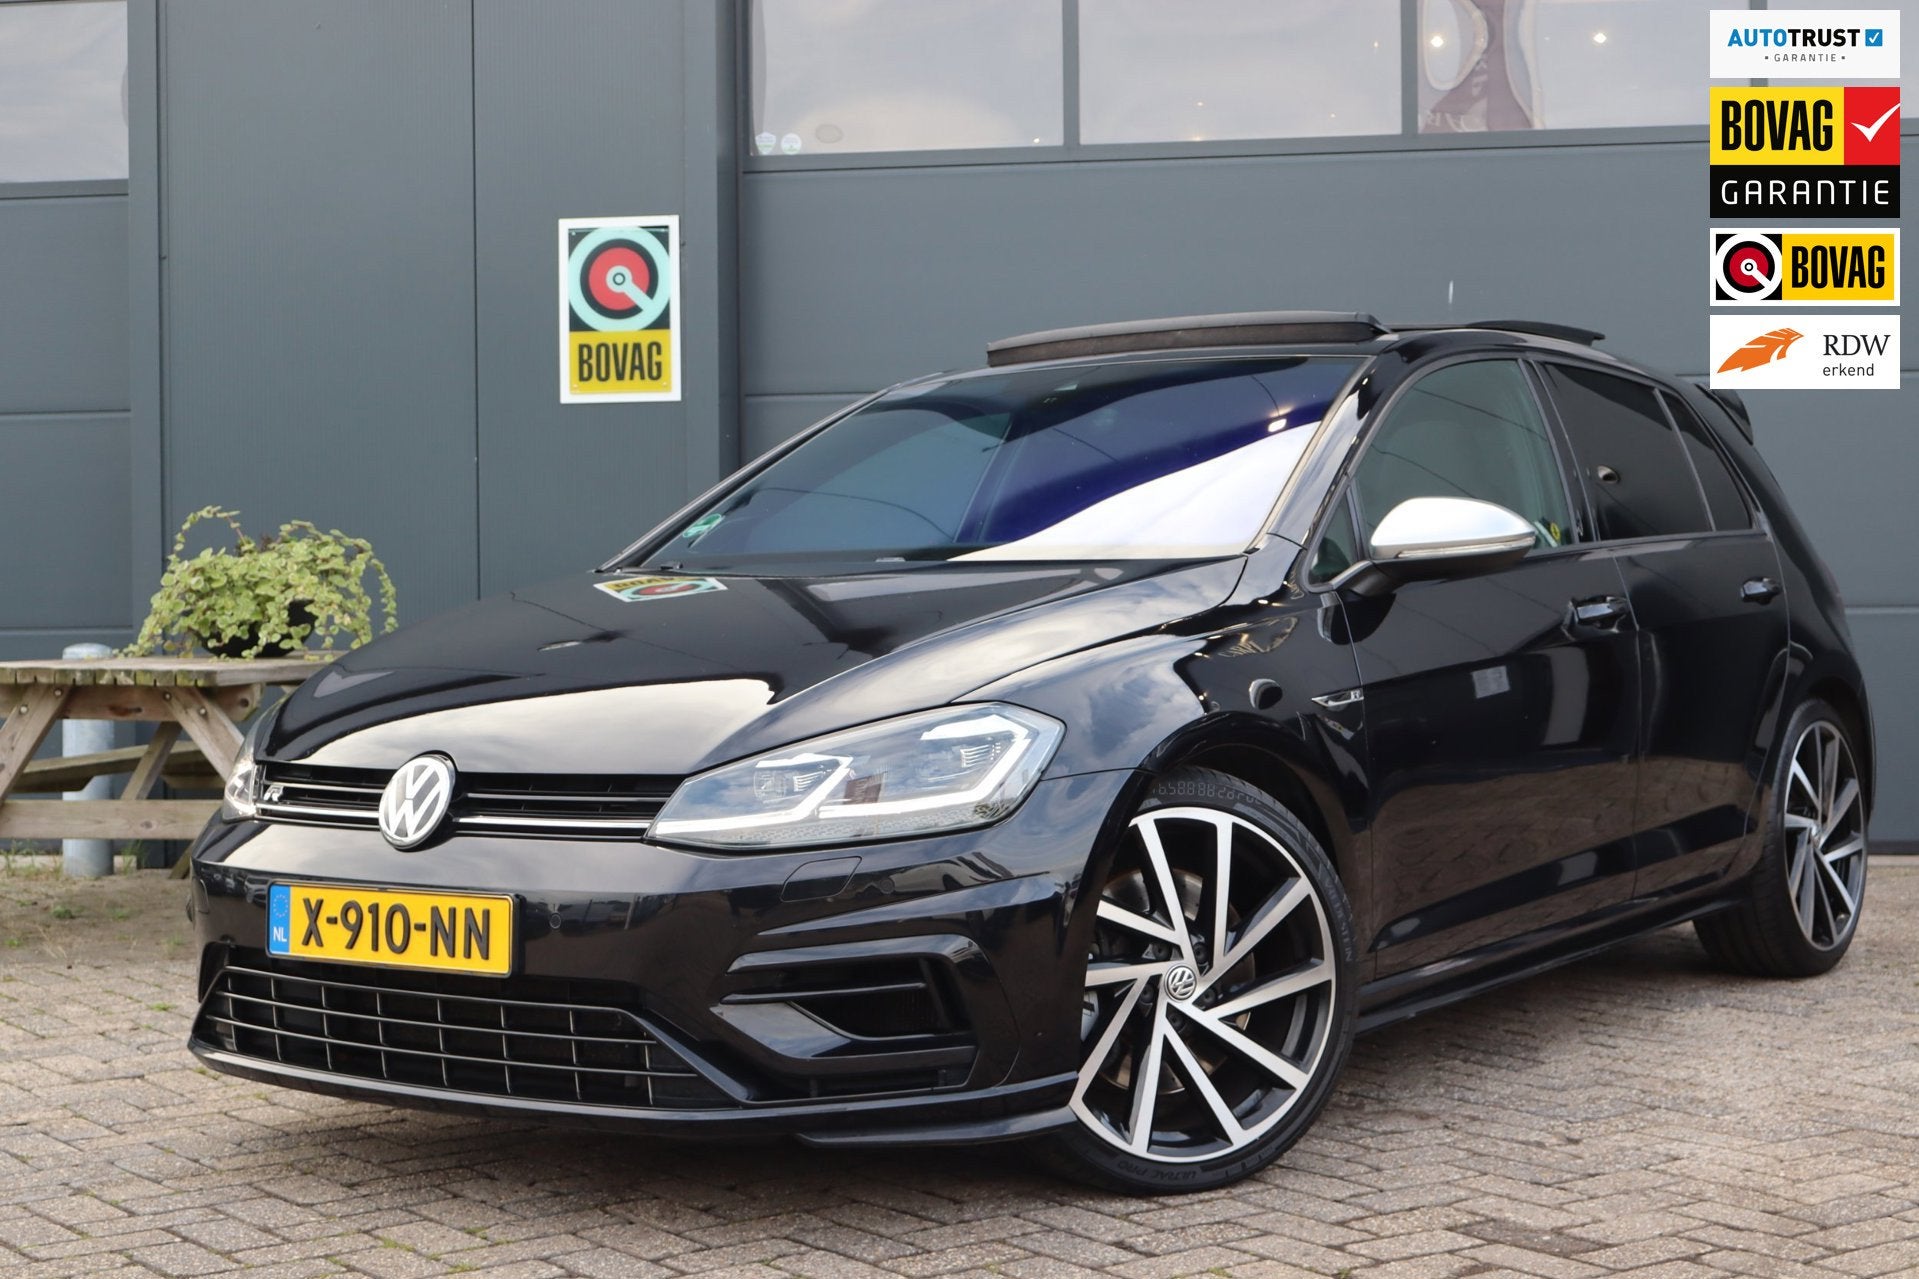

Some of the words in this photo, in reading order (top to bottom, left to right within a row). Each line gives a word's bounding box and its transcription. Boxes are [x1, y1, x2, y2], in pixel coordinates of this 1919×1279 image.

[578, 341, 663, 382] BOVAG
[273, 926, 288, 943] NL
[301, 897, 491, 961] X-910-NN
